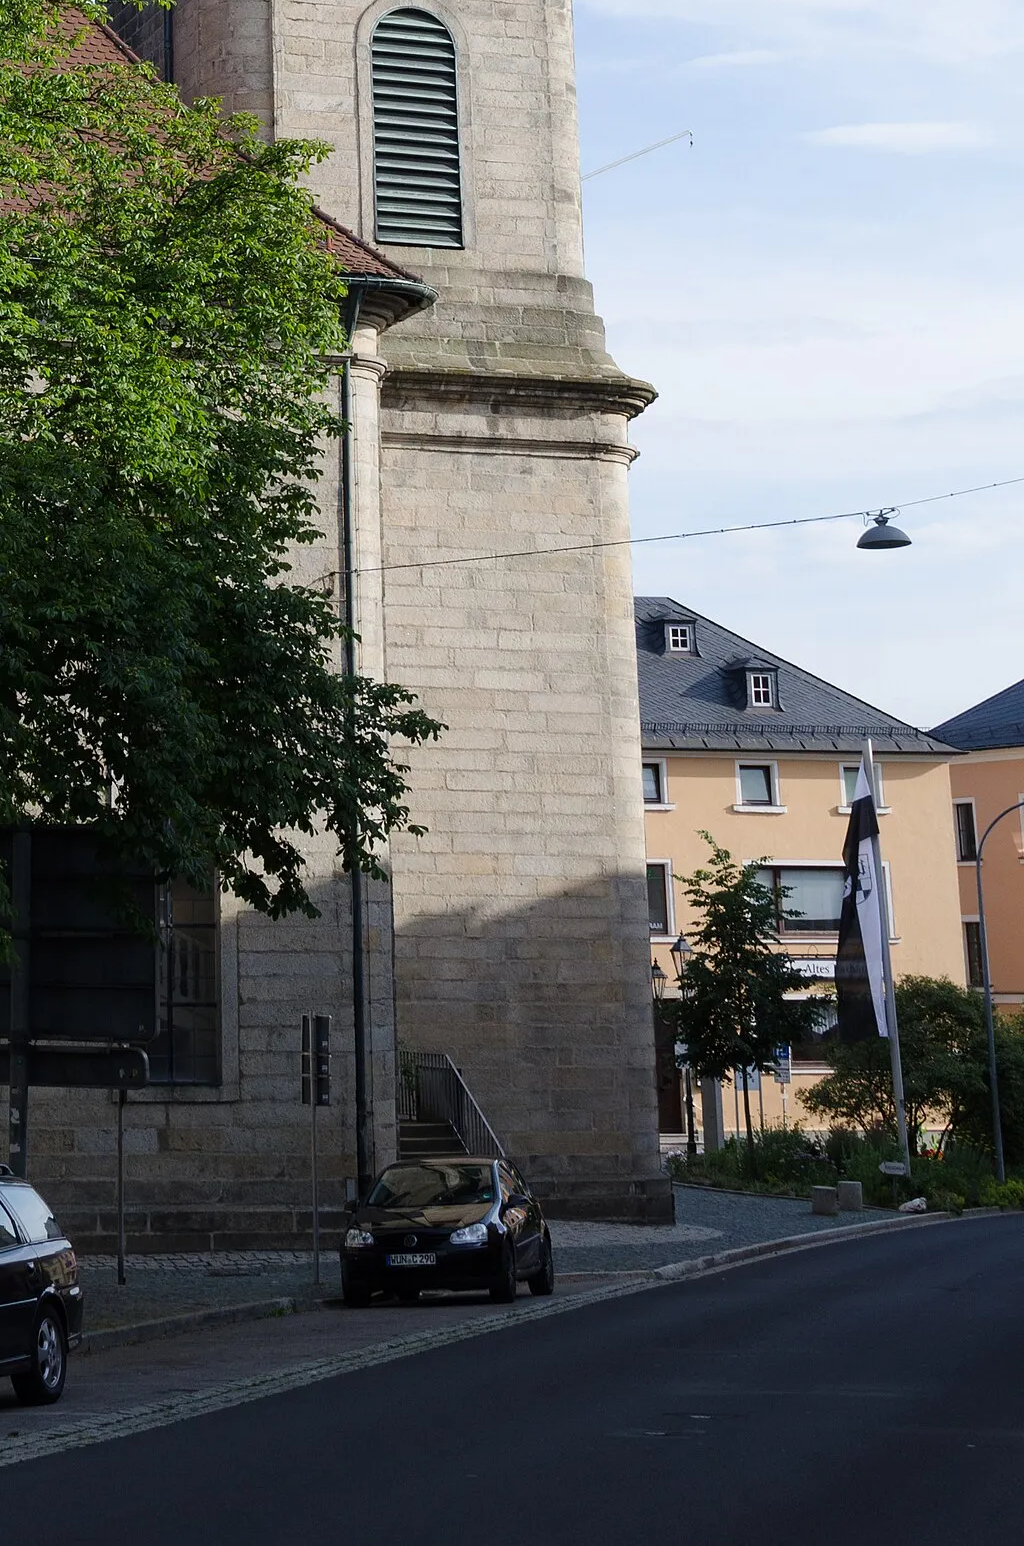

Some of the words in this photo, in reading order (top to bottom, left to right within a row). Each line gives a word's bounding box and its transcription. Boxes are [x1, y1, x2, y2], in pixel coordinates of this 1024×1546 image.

[806, 963, 830, 974] Altes
[390, 1254, 407, 1265] WUN
[412, 1254, 418, 1264] C
[419, 1254, 435, 1264] 290
